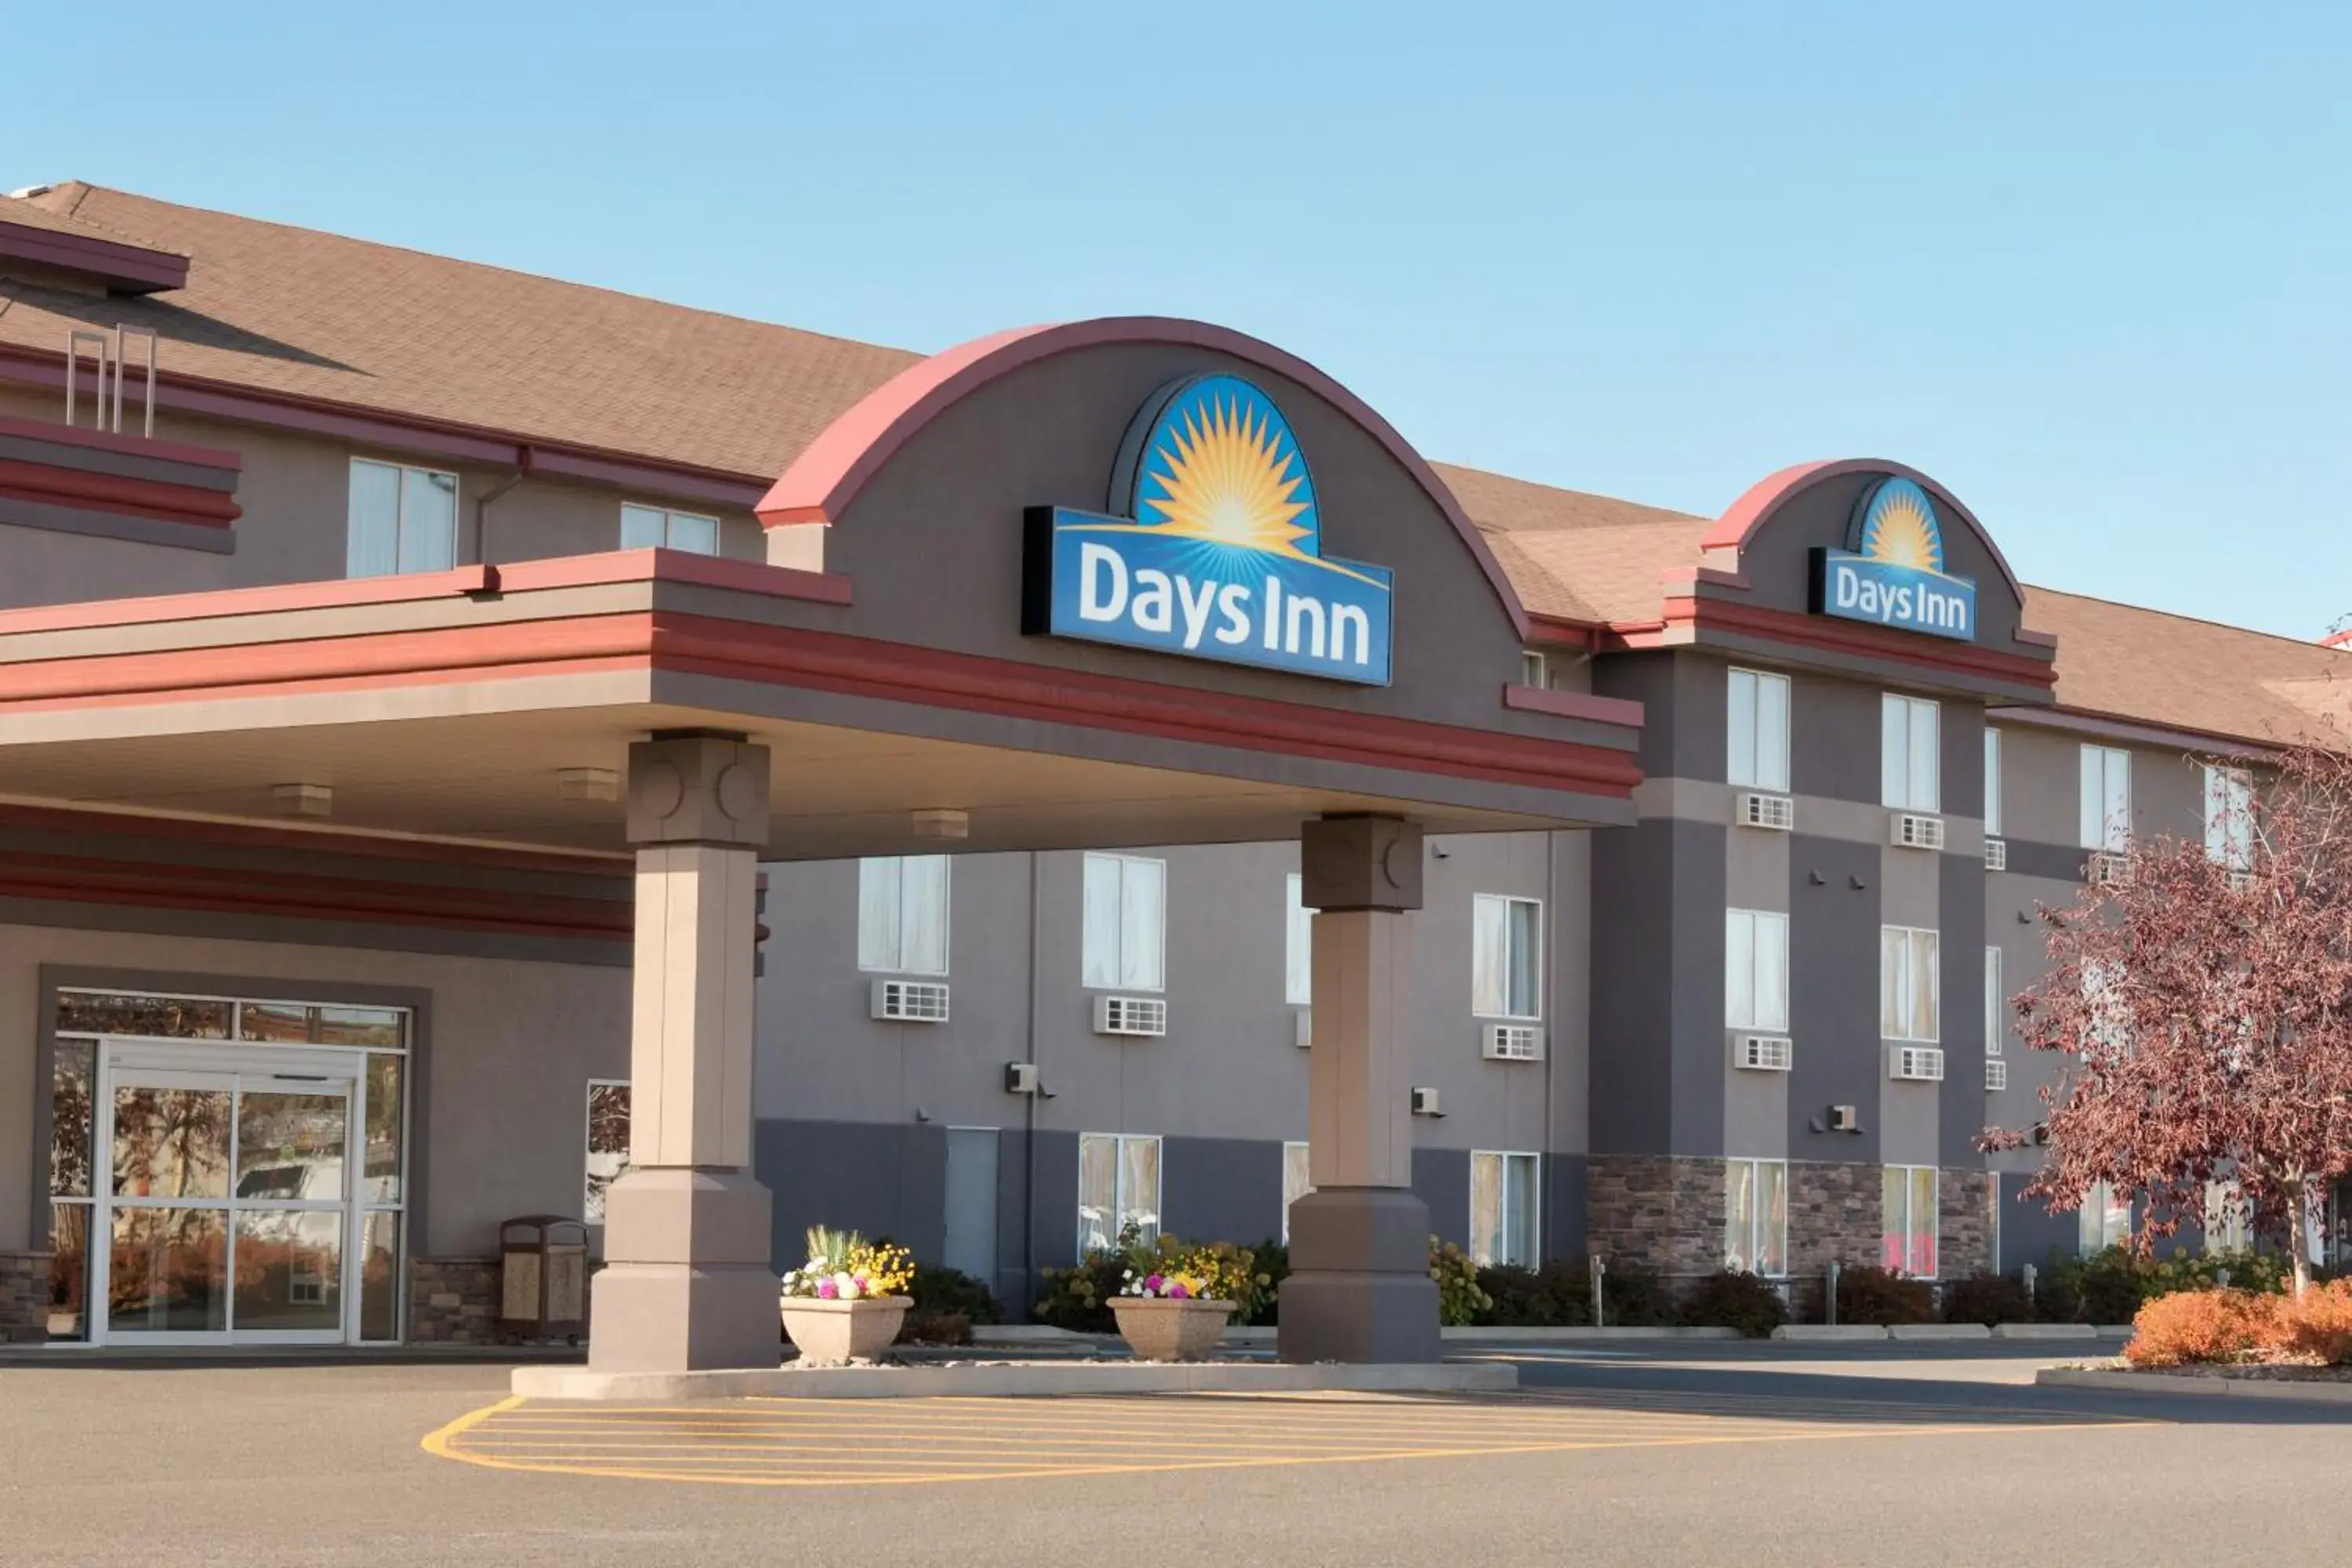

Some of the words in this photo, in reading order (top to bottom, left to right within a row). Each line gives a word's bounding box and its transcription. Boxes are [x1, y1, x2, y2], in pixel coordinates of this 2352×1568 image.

[1080, 542, 1251, 649] Days
[1263, 575, 1369, 665] Inn
[1837, 566, 1912, 622] Days
[1917, 583, 1966, 630] Inn
